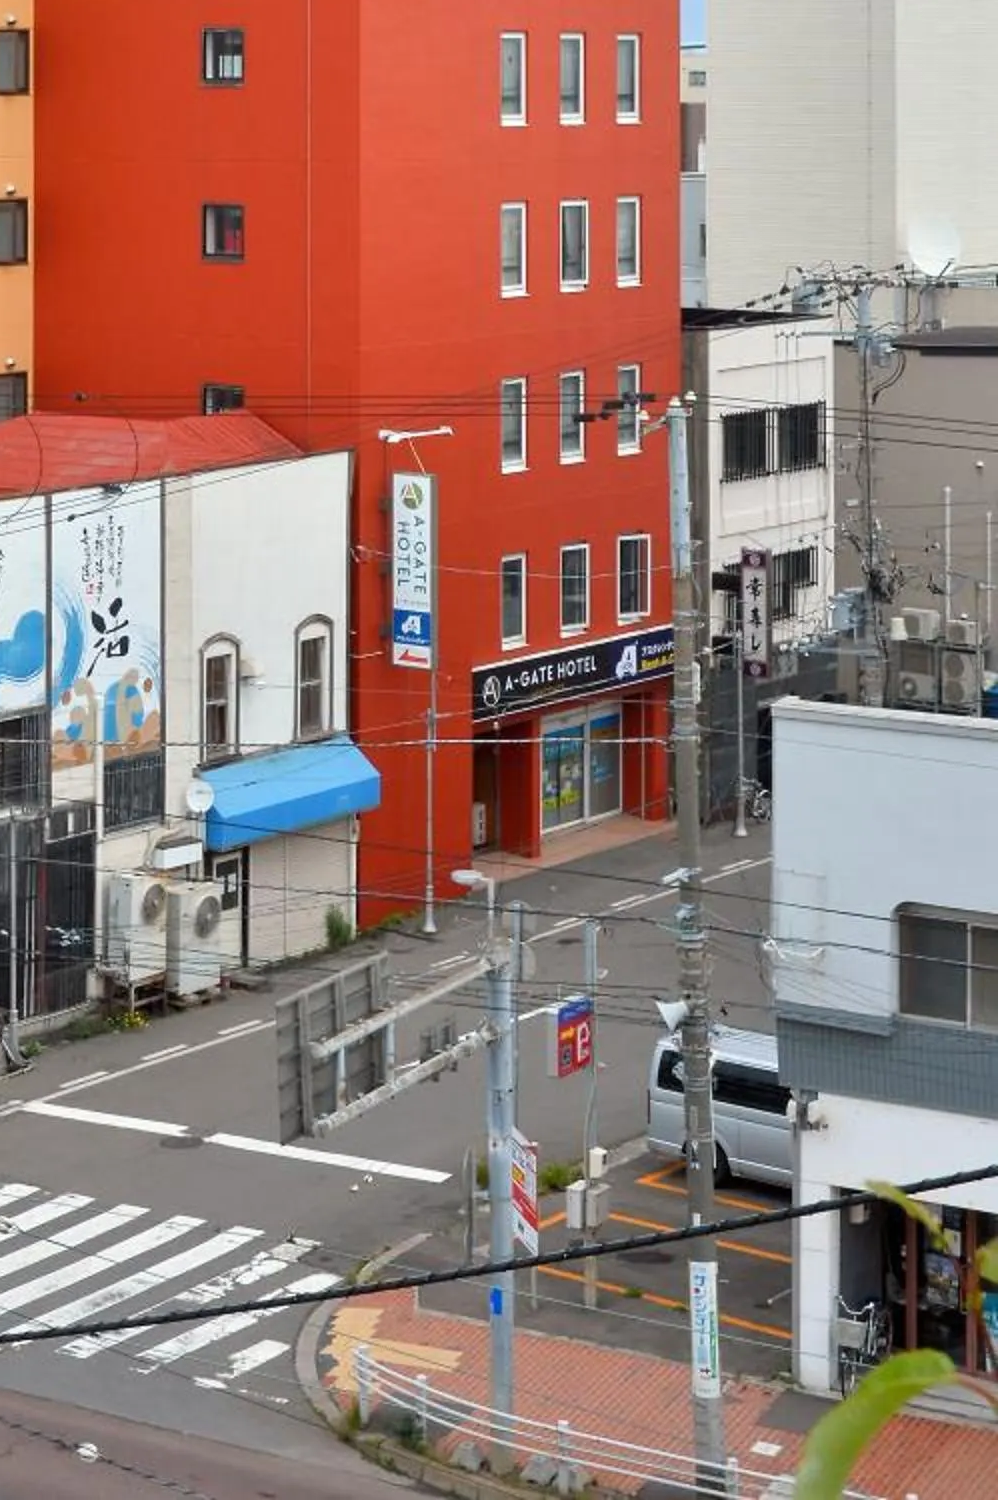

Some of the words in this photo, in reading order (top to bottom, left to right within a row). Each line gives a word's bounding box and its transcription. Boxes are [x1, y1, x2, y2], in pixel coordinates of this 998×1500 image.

[398, 521, 411, 587] HOTEL
[413, 515, 426, 595] A-GATE
[505, 665, 553, 691] A-GATE
[557, 655, 597, 679] HOTEL
